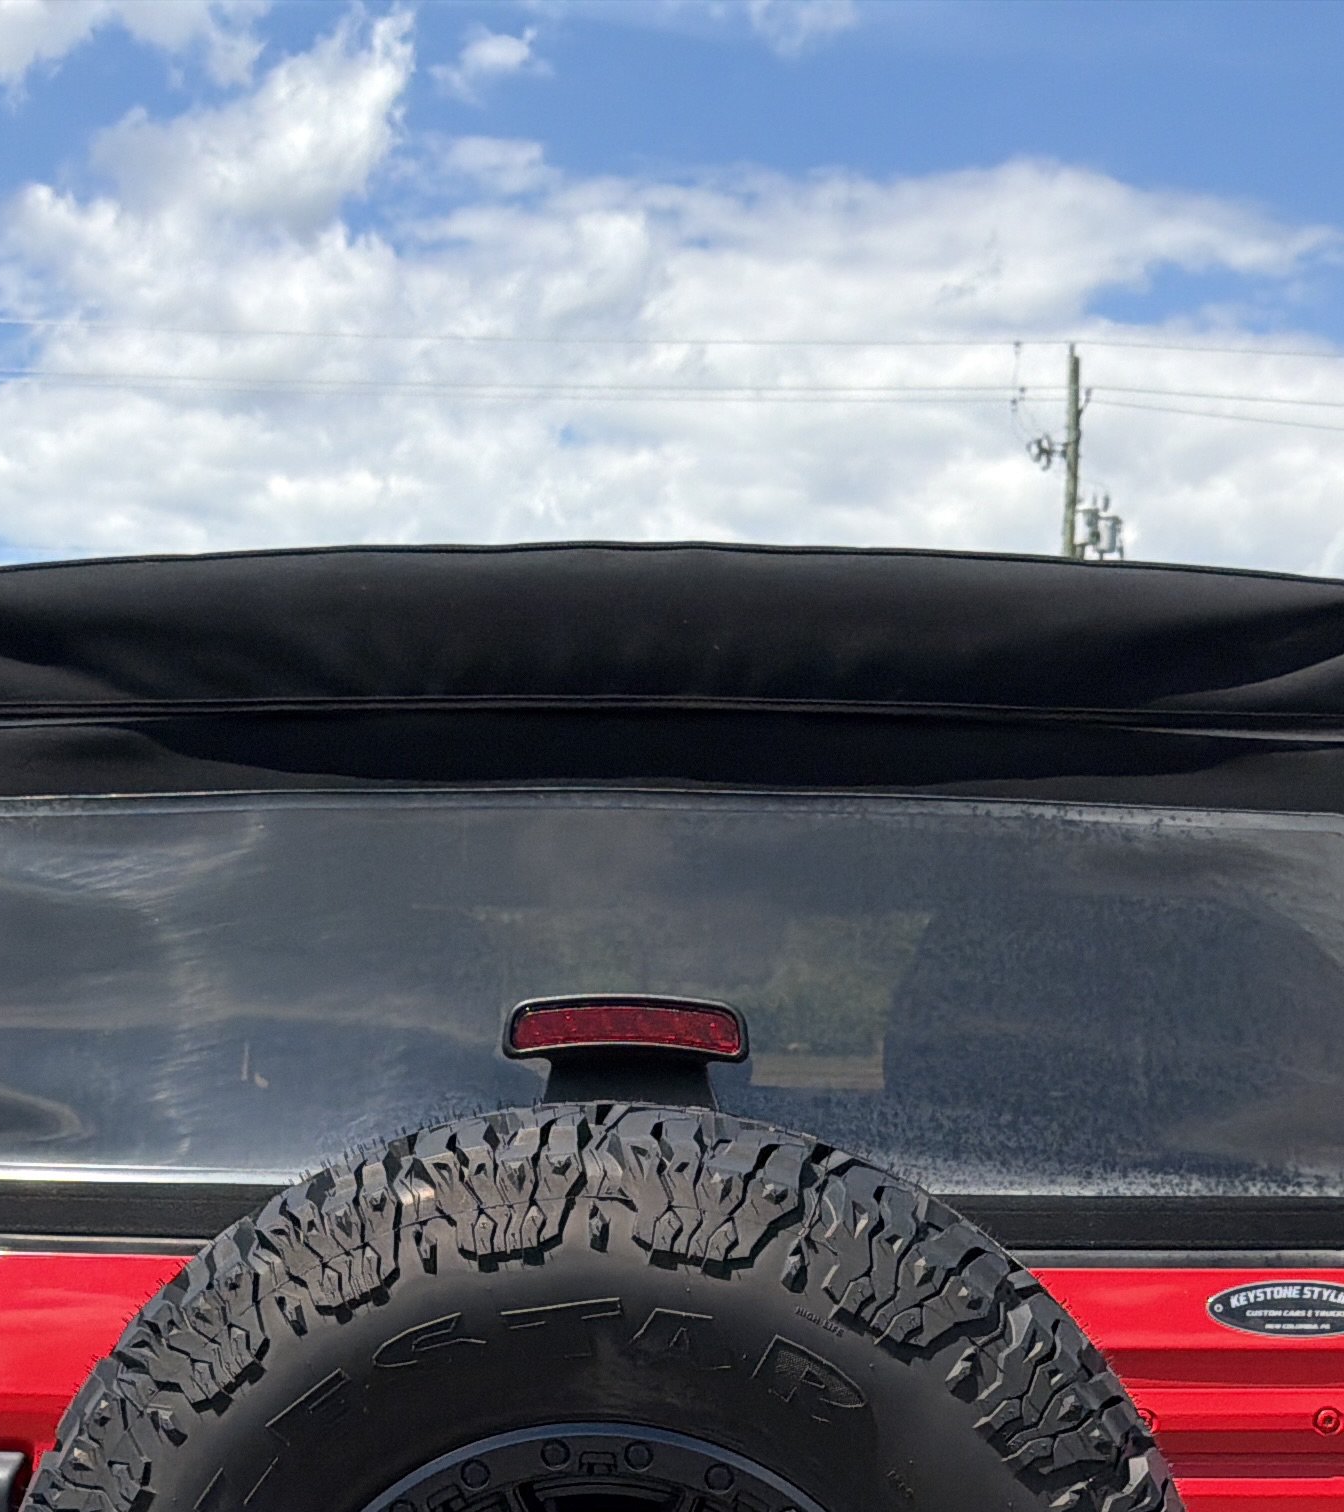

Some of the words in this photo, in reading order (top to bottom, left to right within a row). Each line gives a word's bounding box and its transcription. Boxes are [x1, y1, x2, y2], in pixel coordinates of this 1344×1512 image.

[1230, 1286, 1301, 1308] KEYSTONE
[1246, 1310, 1281, 1318] CUSTOM
[1283, 1310, 1306, 1318] CARS
